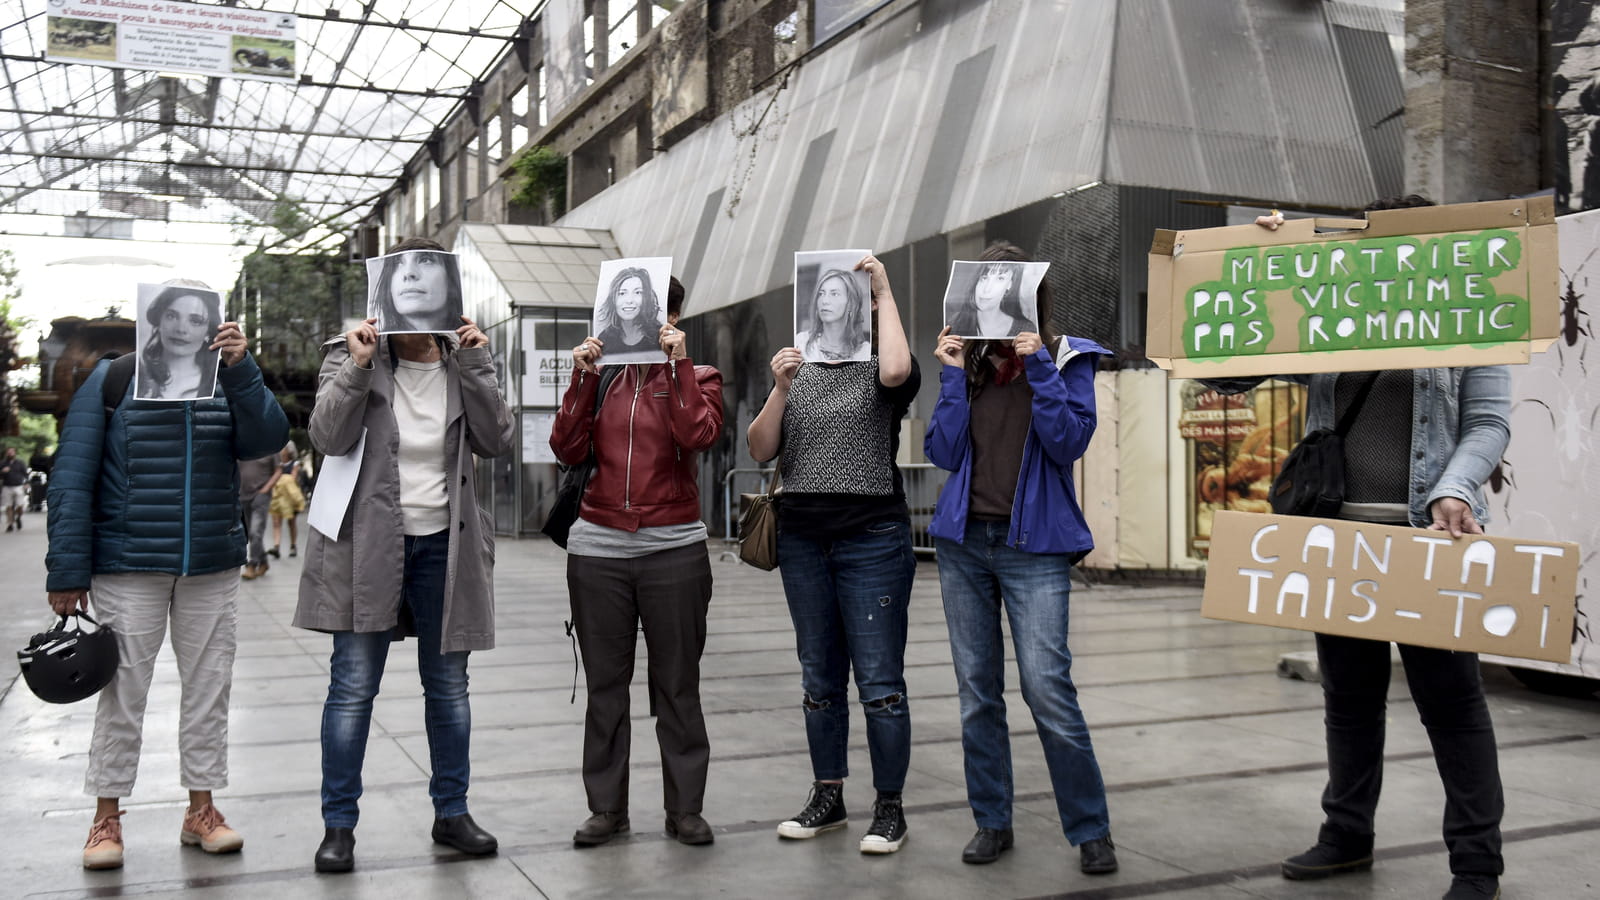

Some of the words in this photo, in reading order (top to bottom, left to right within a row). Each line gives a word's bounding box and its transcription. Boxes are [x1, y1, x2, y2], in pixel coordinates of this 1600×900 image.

[100, 0, 149, 10] Machines
[151, 4, 163, 12] de
[199, 8, 223, 18] leurs
[226, 11, 267, 23] visiteurs
[121, 14, 145, 23] pour
[147, 15, 157, 23] la
[159, 17, 213, 30] sauvegarde
[217, 21, 233, 31] des
[1231, 237, 1512, 285] MEURTRIER
[1193, 288, 1257, 318] PAS
[1300, 273, 1485, 309] VICTIME
[1194, 320, 1264, 352] PAS
[1308, 302, 1516, 345] ROMANTIC
[540, 358, 572, 370] ACCU
[1182, 425, 1202, 437] DES
[1250, 523, 1564, 595] CANTAT
